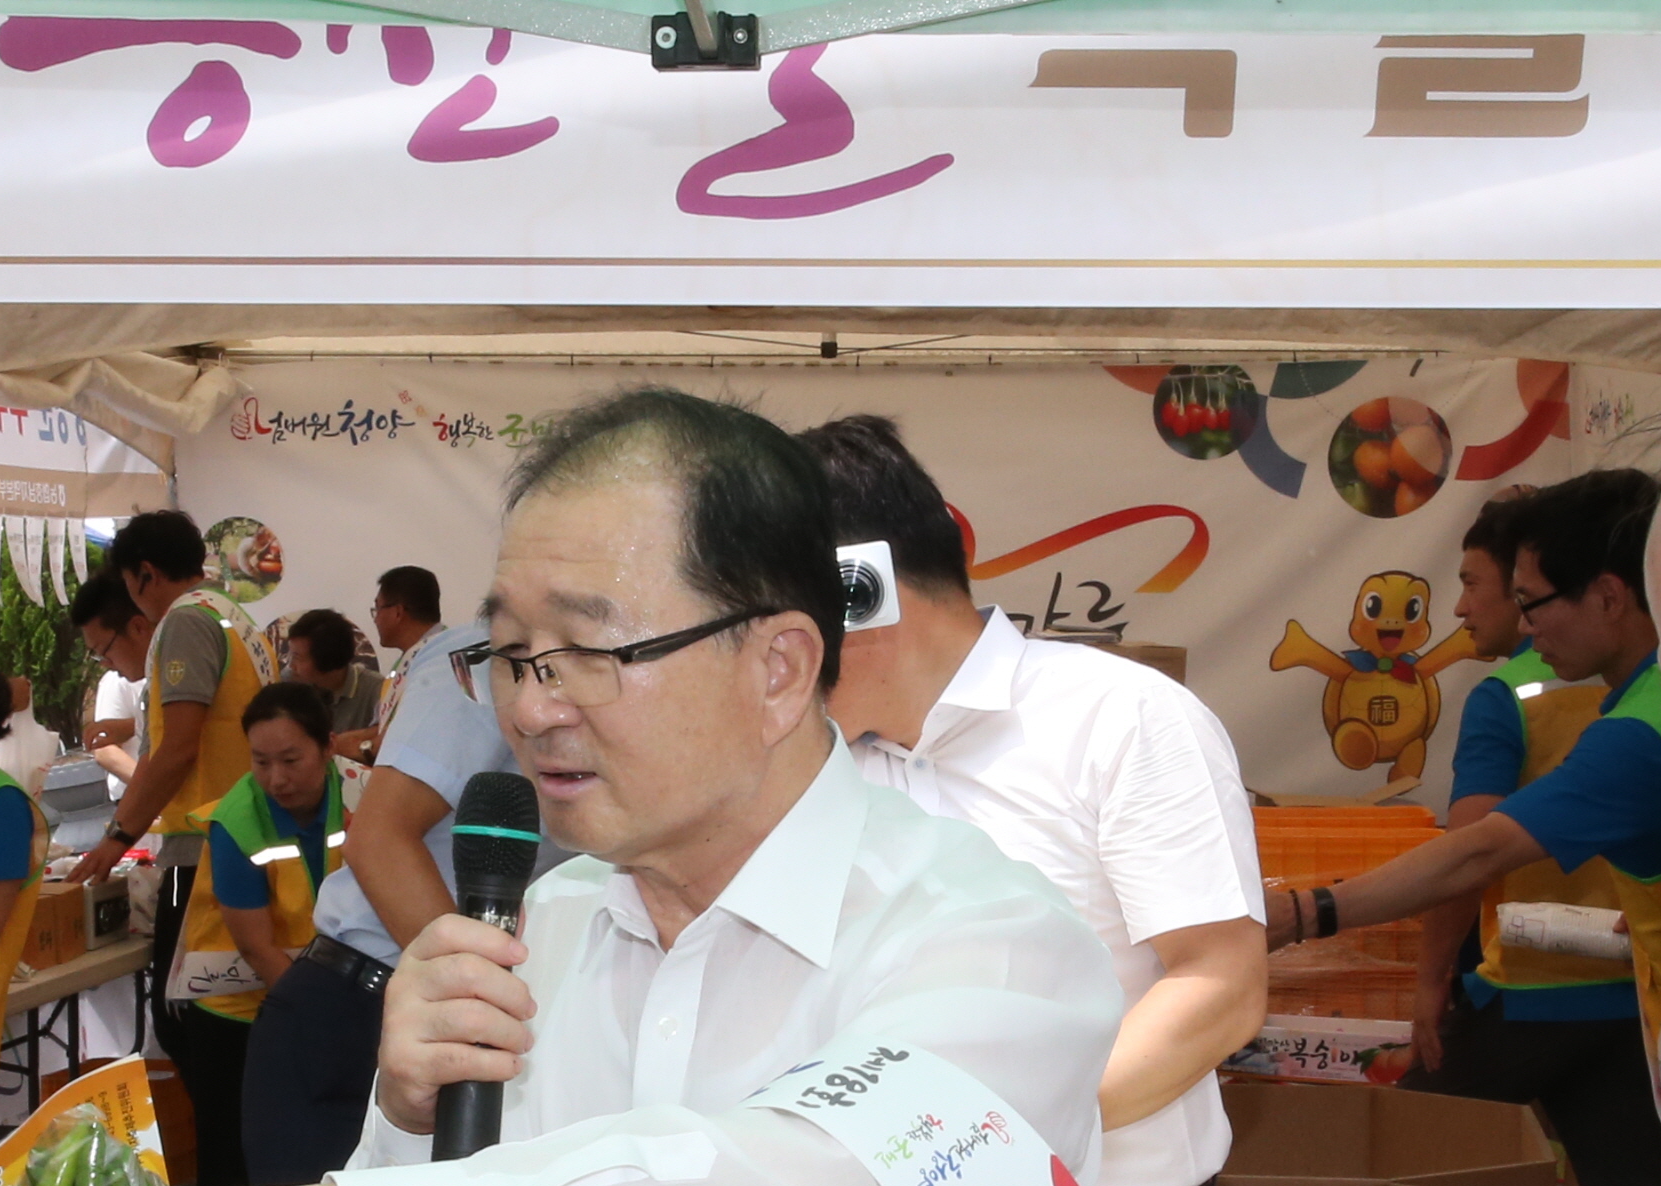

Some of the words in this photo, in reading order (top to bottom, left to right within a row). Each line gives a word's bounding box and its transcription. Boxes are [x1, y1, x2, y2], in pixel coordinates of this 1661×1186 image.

[339, 399, 416, 446] 청양
[432, 412, 495, 449] 행복한
[1370, 698, 1397, 725] 福
[796, 1046, 910, 1110] 제18회
